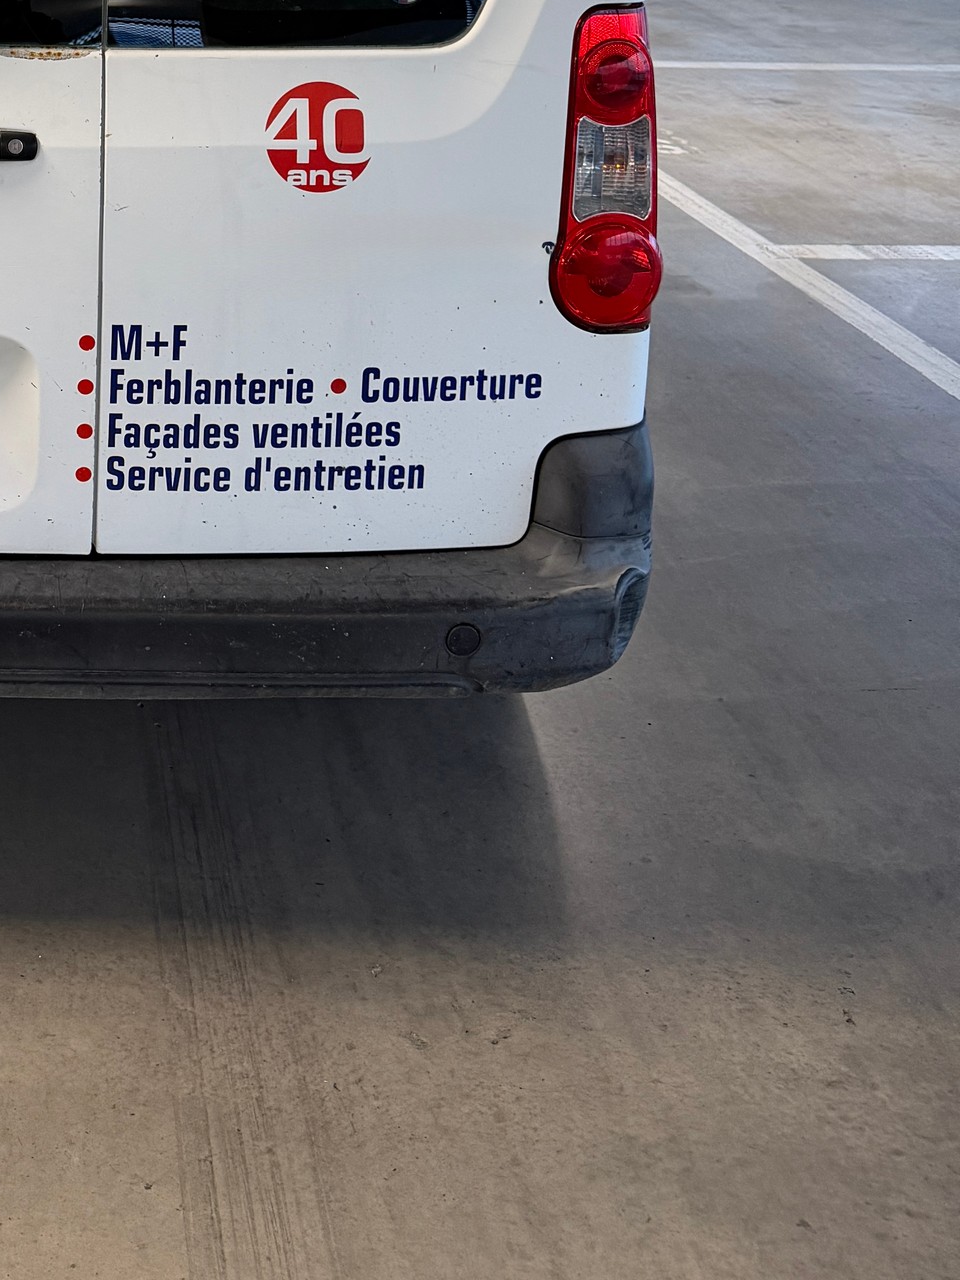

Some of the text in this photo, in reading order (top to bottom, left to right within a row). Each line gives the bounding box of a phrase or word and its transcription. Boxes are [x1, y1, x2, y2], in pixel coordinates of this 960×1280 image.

[265, 98, 373, 164] 40
[287, 169, 353, 186] ans
[110, 324, 188, 361] M+F
[109, 366, 542, 407] Ferblanterie Couverture
[107, 411, 401, 459] Façades ventilées
[106, 454, 425, 493] Service d'entretien
